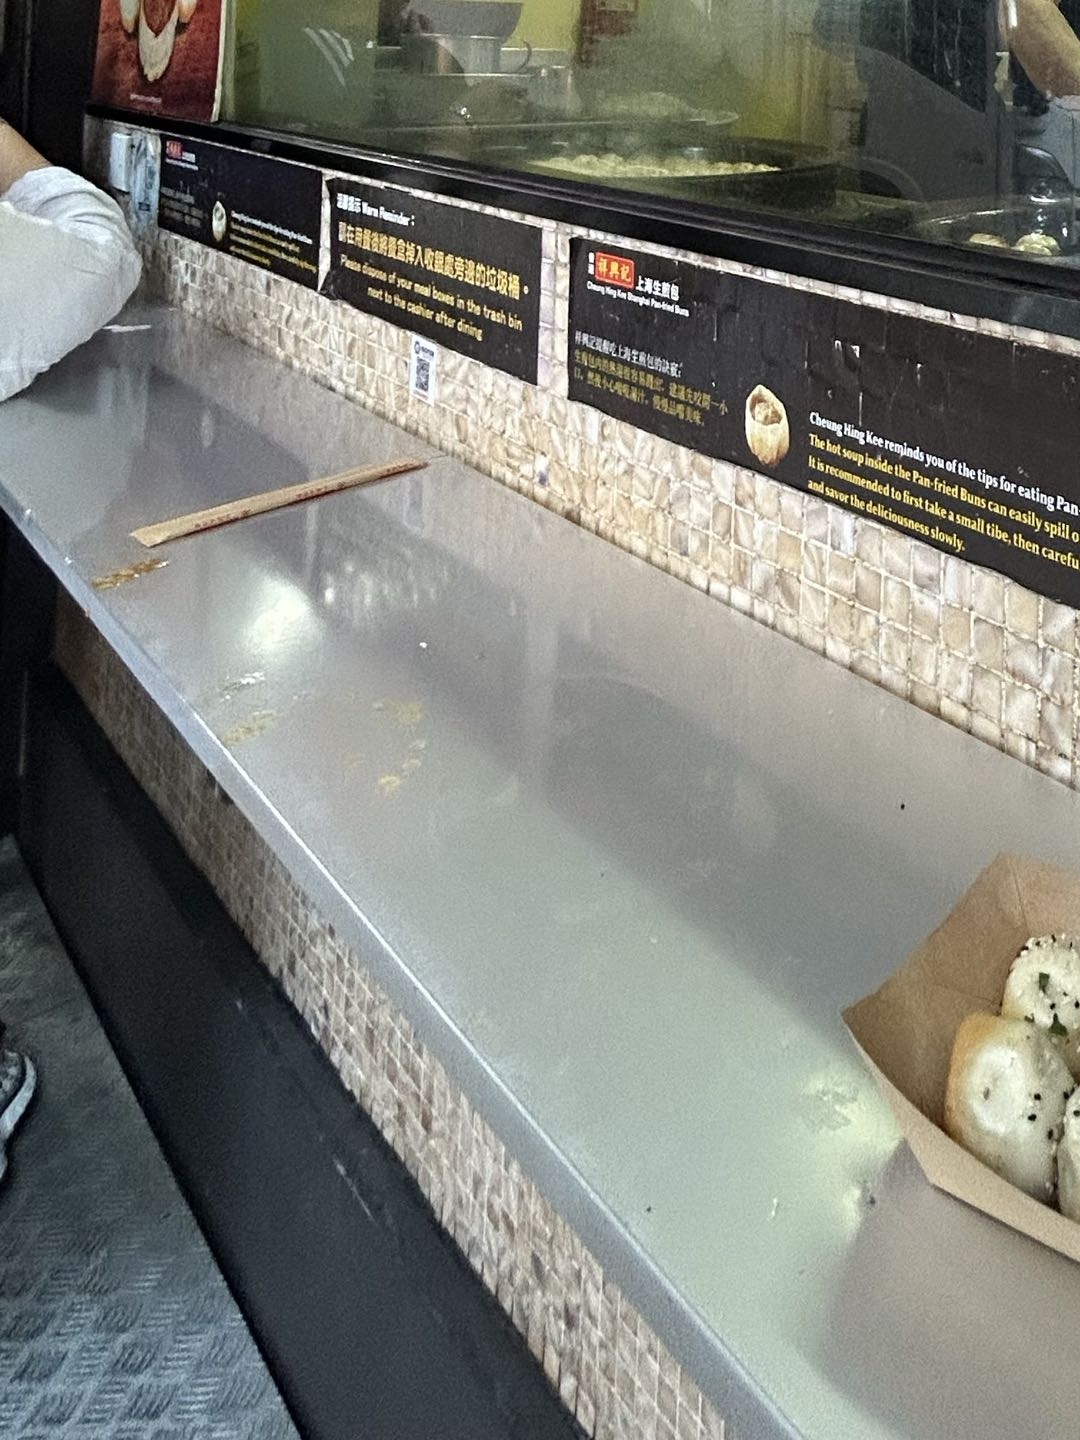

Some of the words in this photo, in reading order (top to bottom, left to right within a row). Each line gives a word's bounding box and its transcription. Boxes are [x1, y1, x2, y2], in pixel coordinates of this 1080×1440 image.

[435, 311, 456, 328] after
[457, 319, 483, 341] dining
[456, 294, 465, 310] in
[467, 299, 481, 315] the
[483, 305, 506, 325] trash
[508, 312, 523, 331] bin
[808, 455, 817, 468] It
[817, 458, 825, 472] is
[825, 463, 890, 497] recommended
[891, 486, 902, 501] to
[903, 489, 924, 510] first
[925, 500, 947, 519] take
[948, 510, 955, 522] a
[956, 512, 985, 536] small
[1013, 532, 1040, 556] then
[809, 412, 843, 437] Cheung
[843, 423, 866, 445] Hing
[866, 430, 884, 448] Kee
[884, 441, 925, 462] reminds
[925, 453, 944, 468] you
[945, 459, 957, 474] of
[957, 462, 976, 479] the
[977, 467, 999, 489] tips
[999, 475, 1017, 494] for
[1017, 485, 1055, 512] eating
[809, 433, 825, 449] The
[826, 439, 841, 456] hot
[842, 447, 864, 467] soup
[864, 453, 894, 475] inside
[894, 465, 912, 481] the
[912, 470, 959, 498] Pan-fried
[960, 487, 987, 509] Buns
[988, 500, 1007, 517] can
[1009, 507, 1044, 533] easily
[1044, 520, 1070, 539] spill
[808, 478, 825, 494] and
[825, 485, 850, 503] savor
[850, 494, 865, 510] the
[866, 500, 930, 536] deliciousness
[930, 526, 966, 553] slowly.
